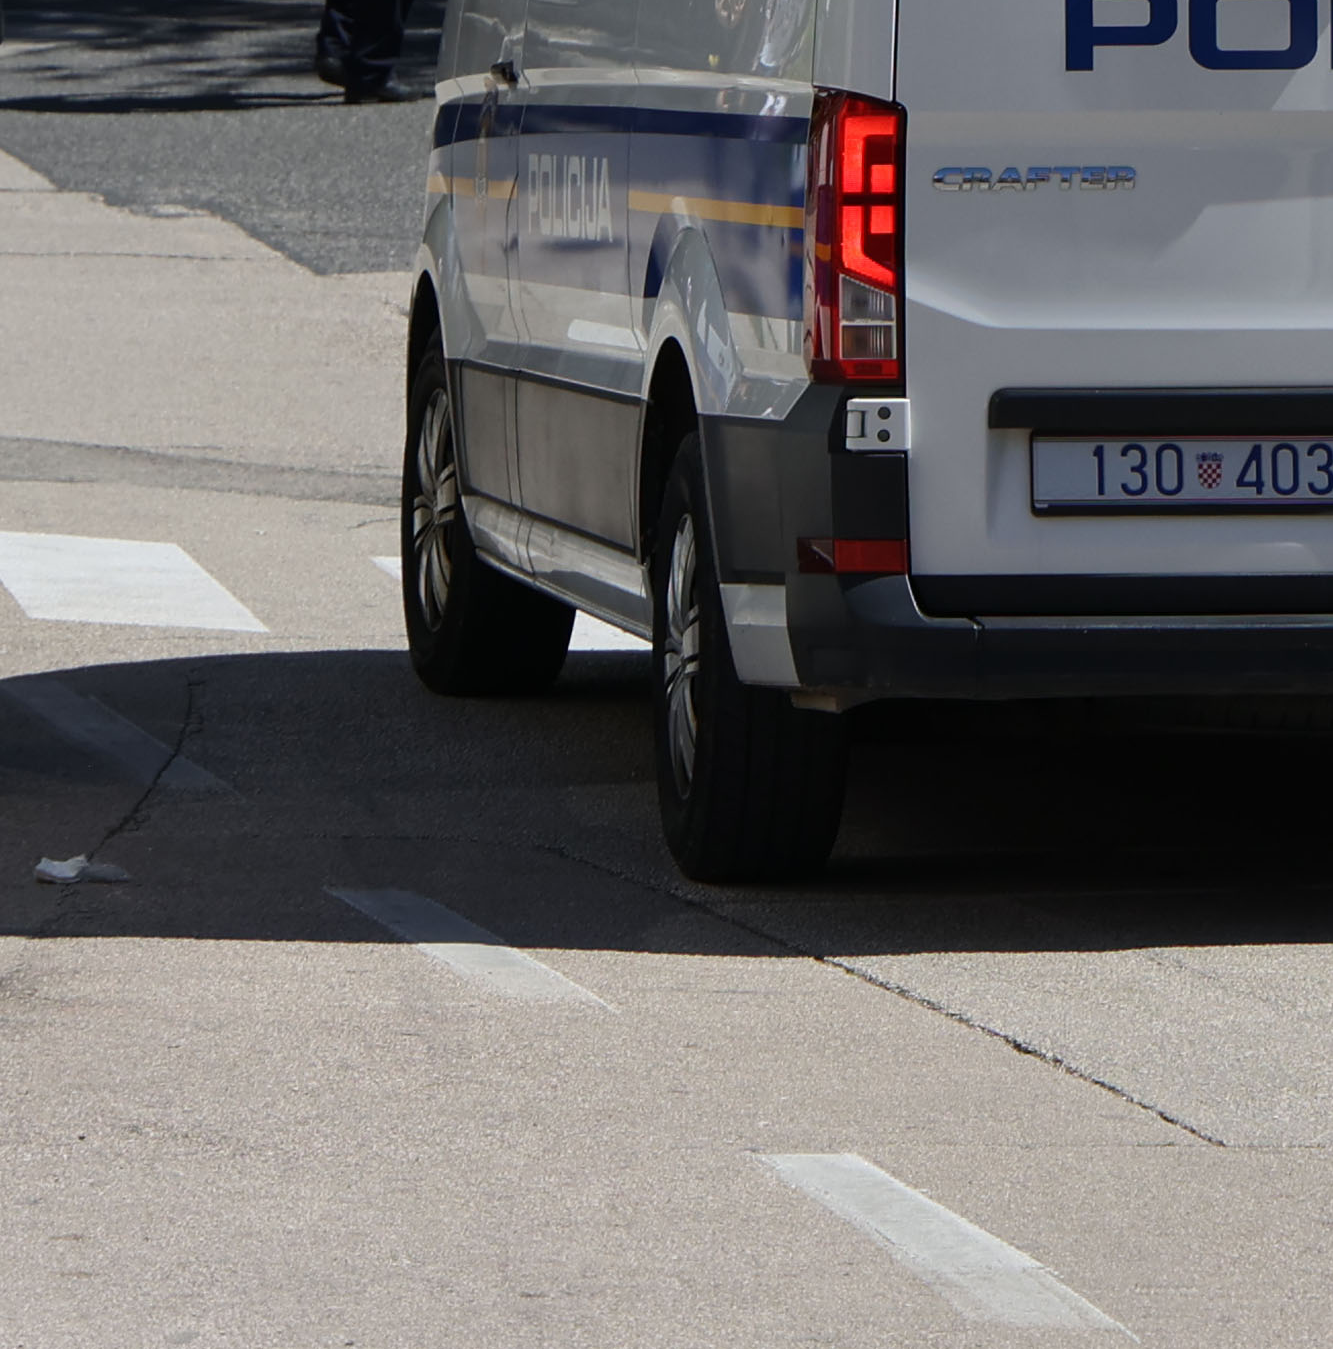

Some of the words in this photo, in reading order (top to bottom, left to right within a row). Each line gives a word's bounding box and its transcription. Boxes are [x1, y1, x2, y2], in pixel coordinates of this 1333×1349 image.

[528, 154, 613, 243] POLICIJA
[932, 166, 1137, 192] CRAFTER
[1092, 444, 1185, 496] 130
